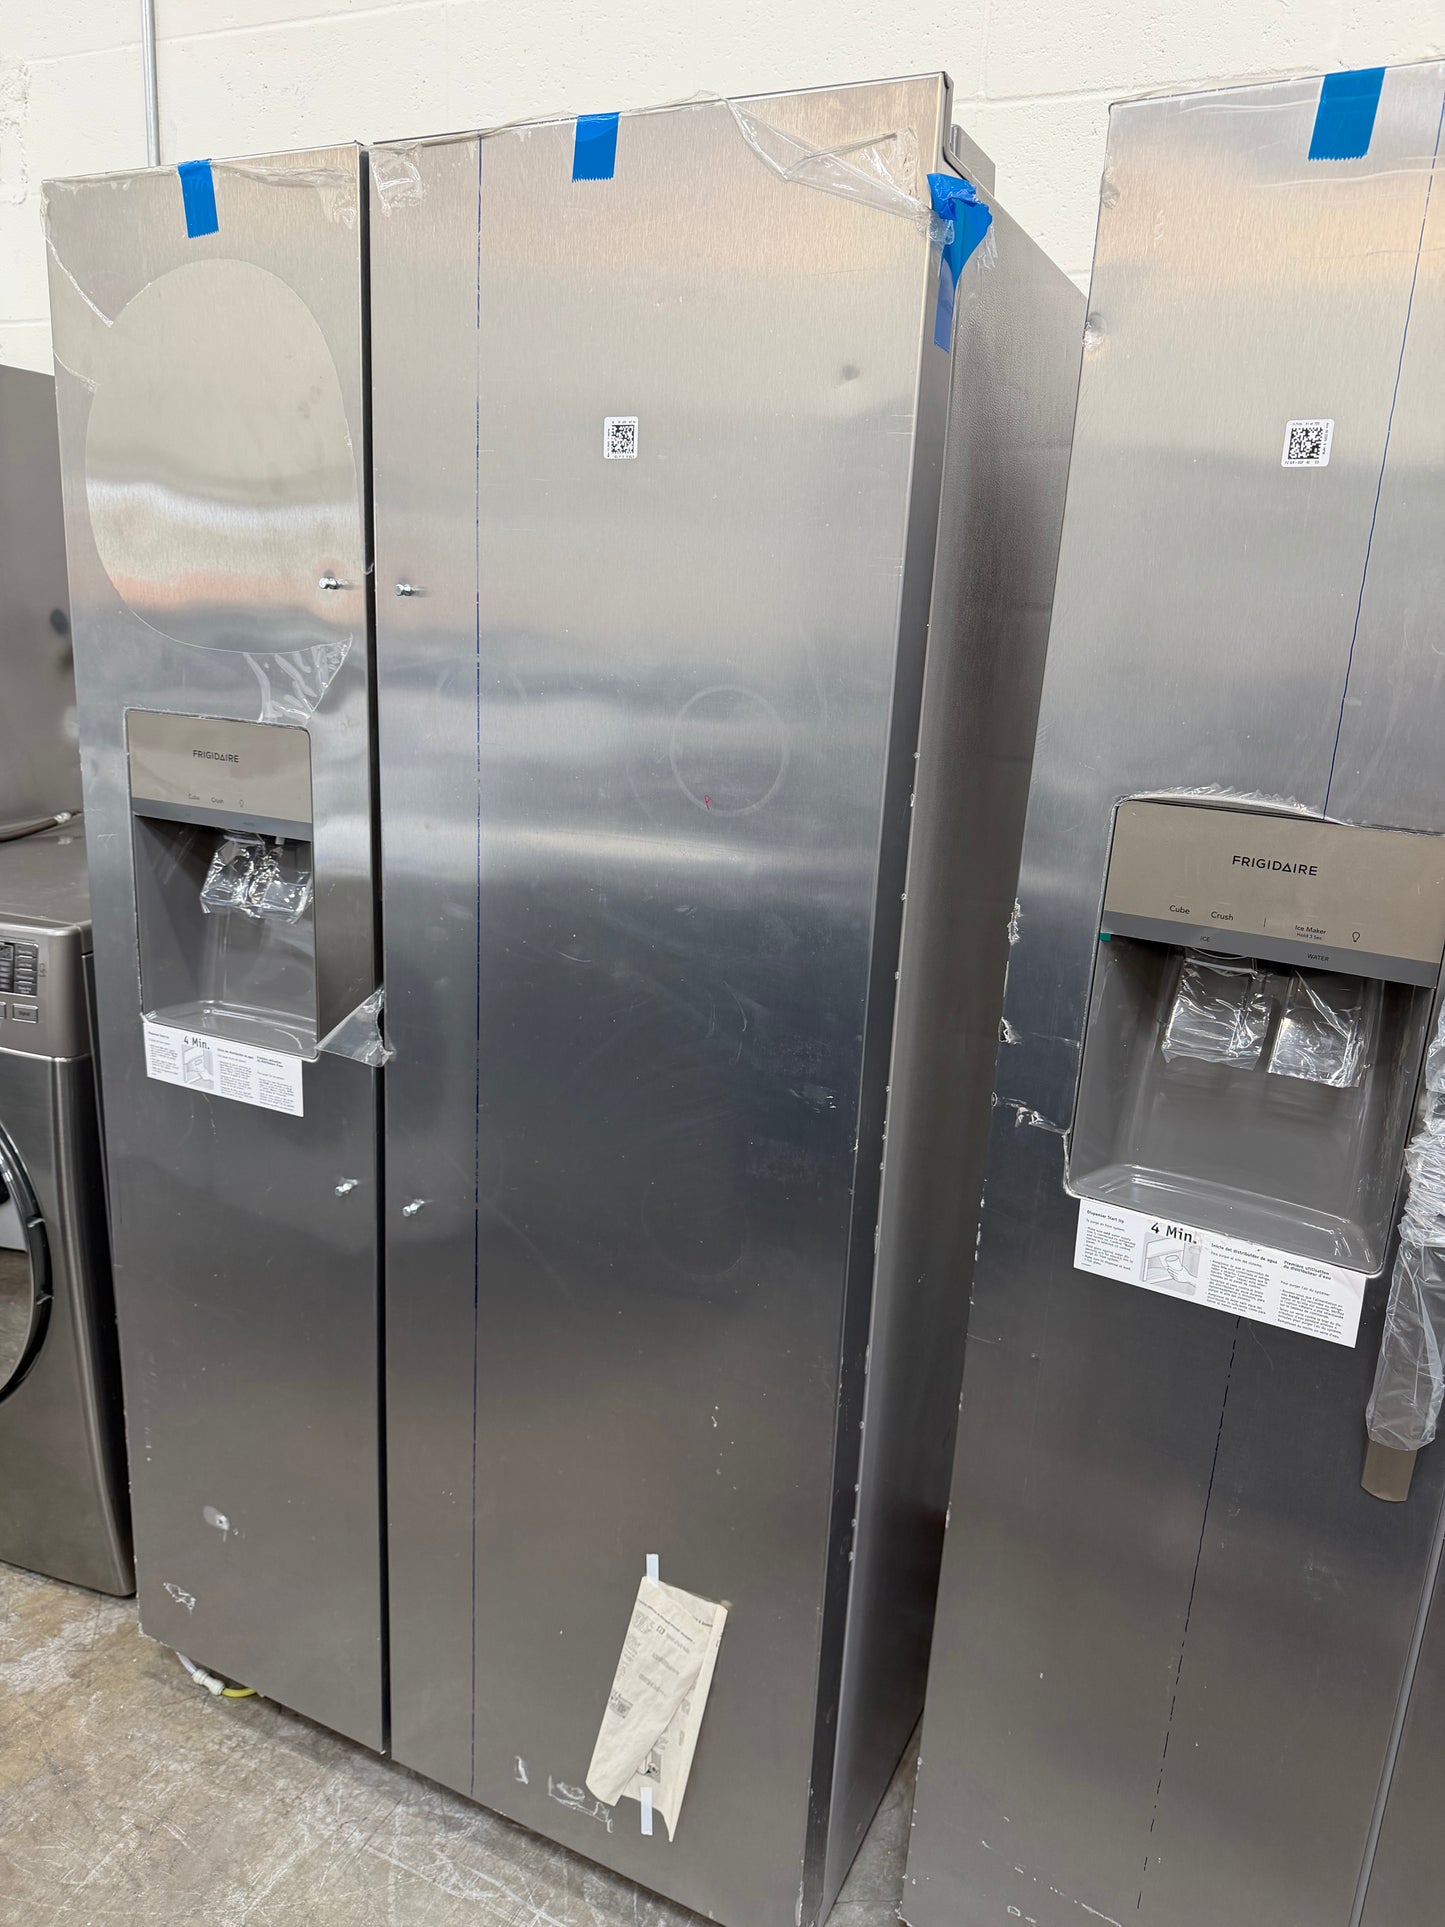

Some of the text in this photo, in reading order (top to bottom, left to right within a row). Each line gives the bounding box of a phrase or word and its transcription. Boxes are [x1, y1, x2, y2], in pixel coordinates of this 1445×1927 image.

[193, 749, 240, 763] FRIGIDAIRE
[1232, 855, 1318, 876] FRIGIDAIRE
[1169, 904, 1190, 915] Cube
[1210, 911, 1234, 922] Crush
[1306, 926, 1326, 935] Maker
[1307, 952, 1329, 961] WATER
[183, 1035, 189, 1045] 4
[192, 1036, 210, 1050] Min.
[1150, 1222, 1197, 1244] 4 Min.
